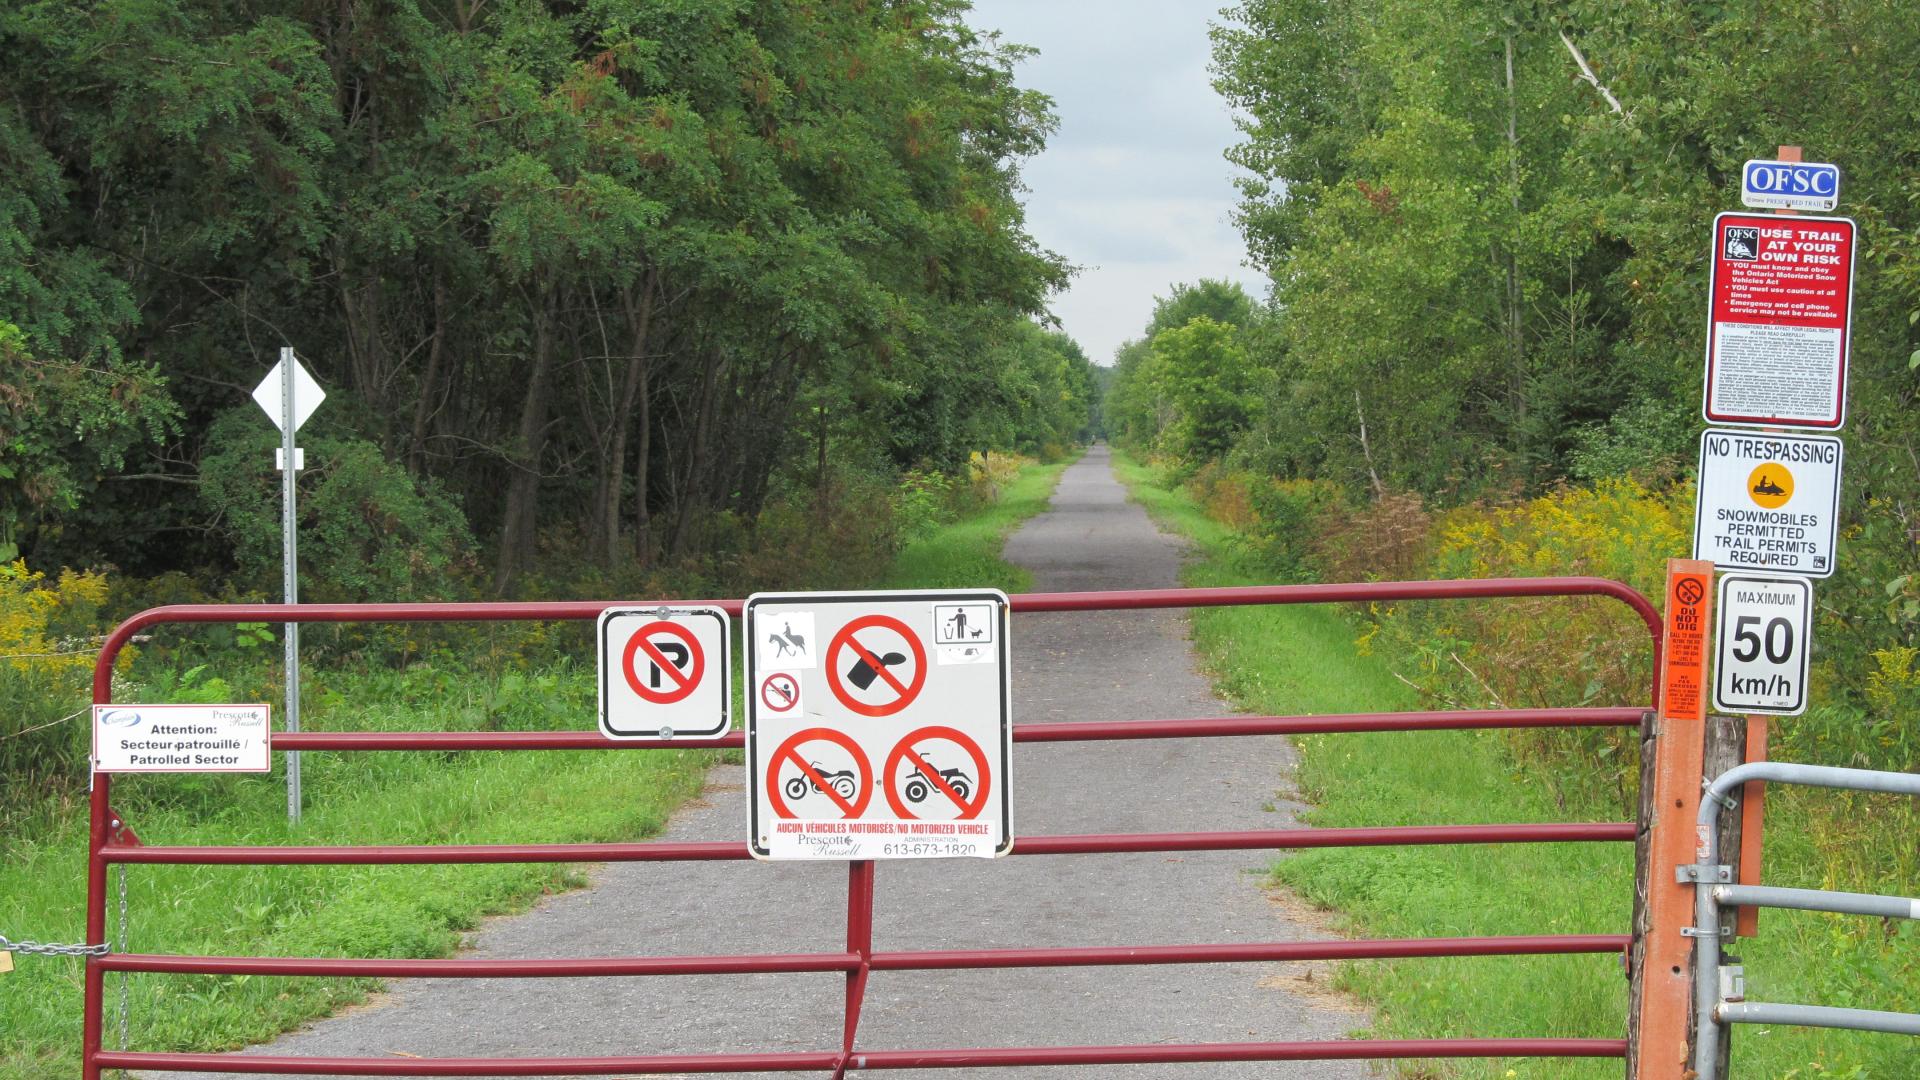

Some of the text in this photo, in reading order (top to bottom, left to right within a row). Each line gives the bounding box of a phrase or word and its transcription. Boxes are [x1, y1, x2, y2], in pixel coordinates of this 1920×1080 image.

[1750, 167, 1833, 194] OFSC
[1728, 228, 1757, 239] OFSC
[1761, 228, 1844, 241] USE TRAIL
[1767, 241, 1836, 253] AT YOUR
[1761, 252, 1840, 264] OWN RISK
[1776, 272, 1813, 280] Motorized
[1730, 299, 1772, 308] Emergency
[1709, 437, 1834, 464] NO TRESPASSING
[1717, 509, 1817, 526] SNOWMOBILES
[1728, 523, 1804, 539] PERMITTED
[1715, 536, 1816, 554] TRAIL PERMITS
[1730, 550, 1798, 566] REQUIRED
[1737, 591, 1795, 606] MAXIMUM
[1676, 615, 1700, 623] NOT
[1732, 615, 1794, 665] 50
[1731, 673, 1791, 697] km/h
[213, 710, 250, 719] Prescott
[151, 725, 217, 735] Attention:
[121, 740, 171, 750] Secteur
[177, 739, 240, 751] patrouillé
[130, 754, 239, 764] Patrolled Sector
[777, 823, 803, 833] AUCUN
[806, 822, 846, 833] VÉHICULES
[911, 824, 955, 834] MOTORIZED
[958, 824, 988, 834] VEHICLE
[798, 834, 845, 844] Prescott
[813, 844, 861, 856] Russell
[884, 844, 976, 855] 613-673-1820
